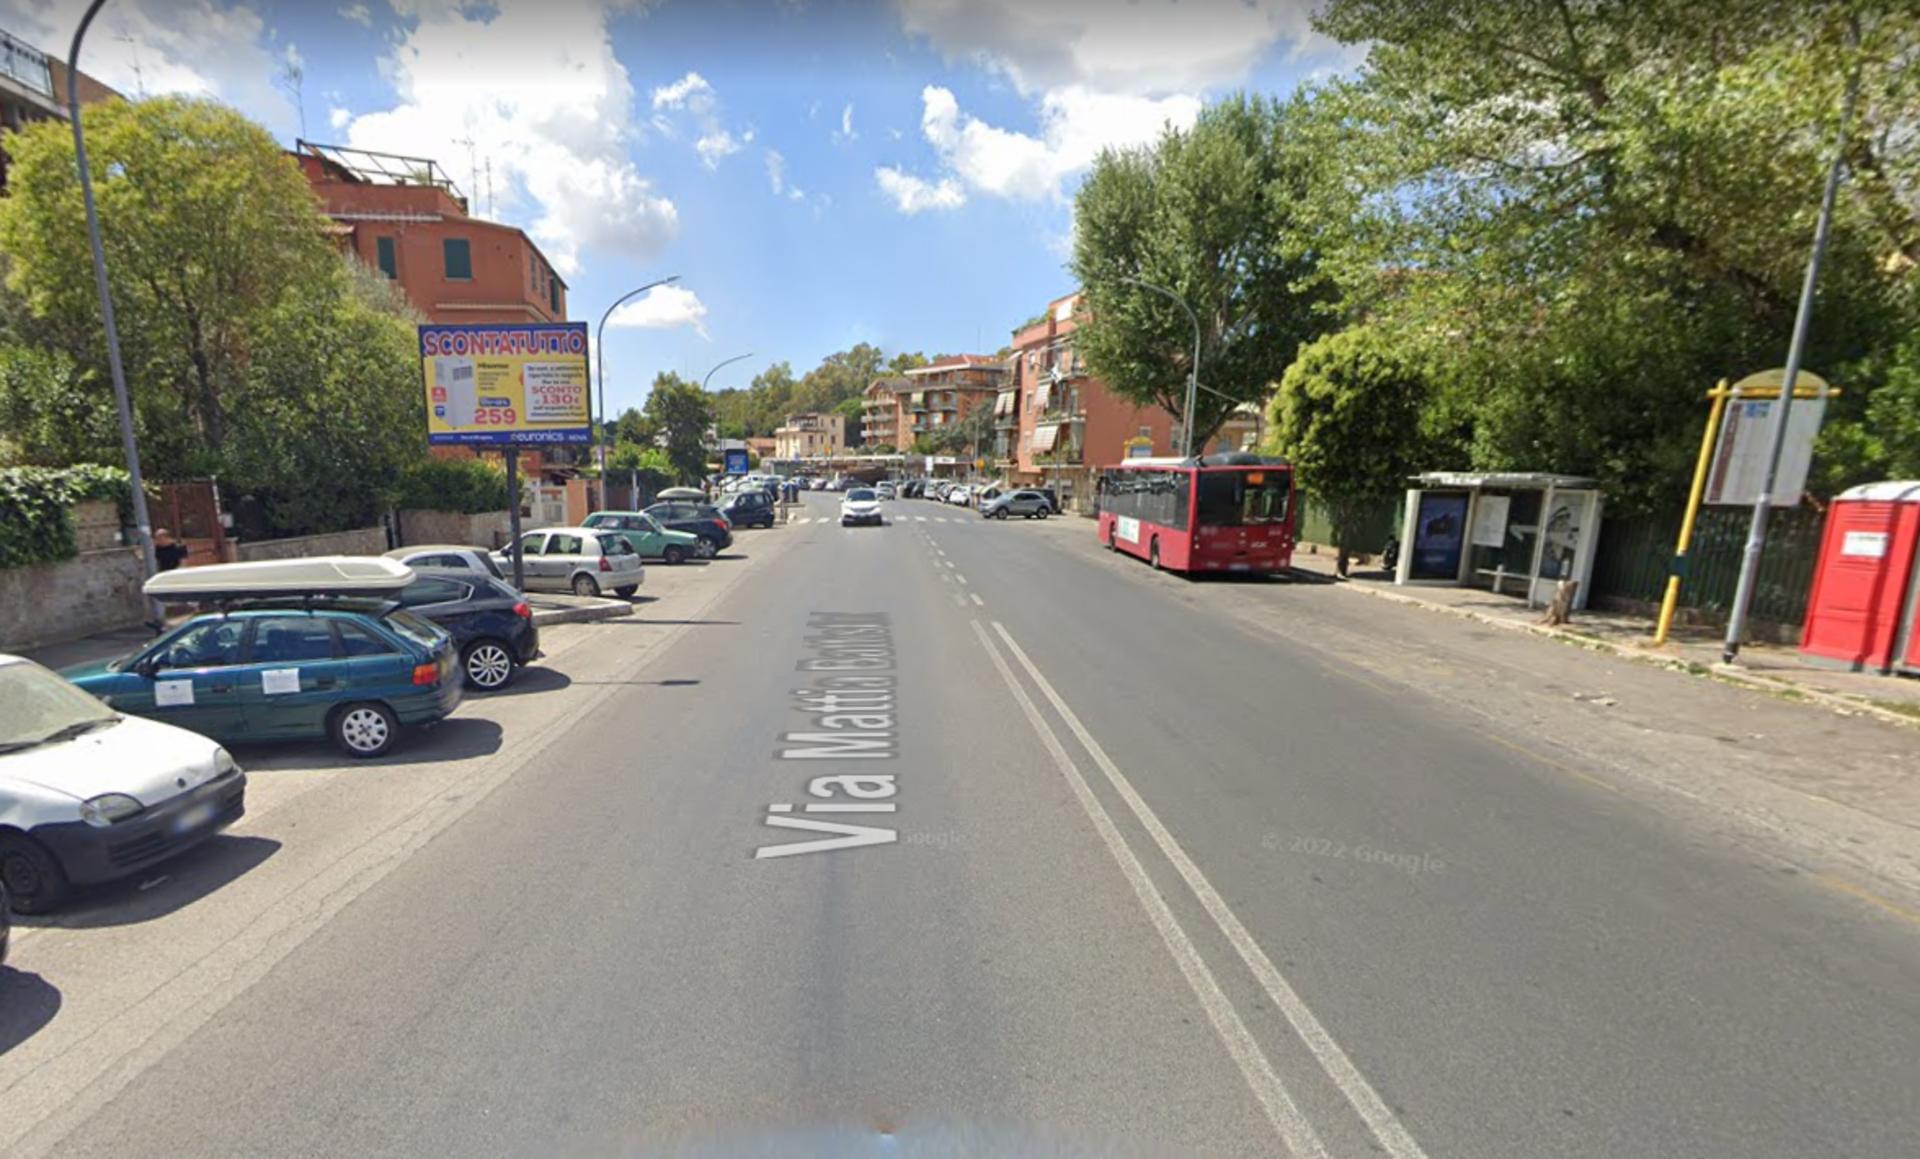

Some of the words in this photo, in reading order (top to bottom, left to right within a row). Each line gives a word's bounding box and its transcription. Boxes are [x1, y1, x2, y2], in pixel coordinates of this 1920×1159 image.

[424, 330, 586, 355] SCONTATUTTO
[531, 386, 582, 394] SCONTO
[543, 394, 573, 404] 130
[474, 408, 516, 424] 259
[517, 431, 564, 442] euronics
